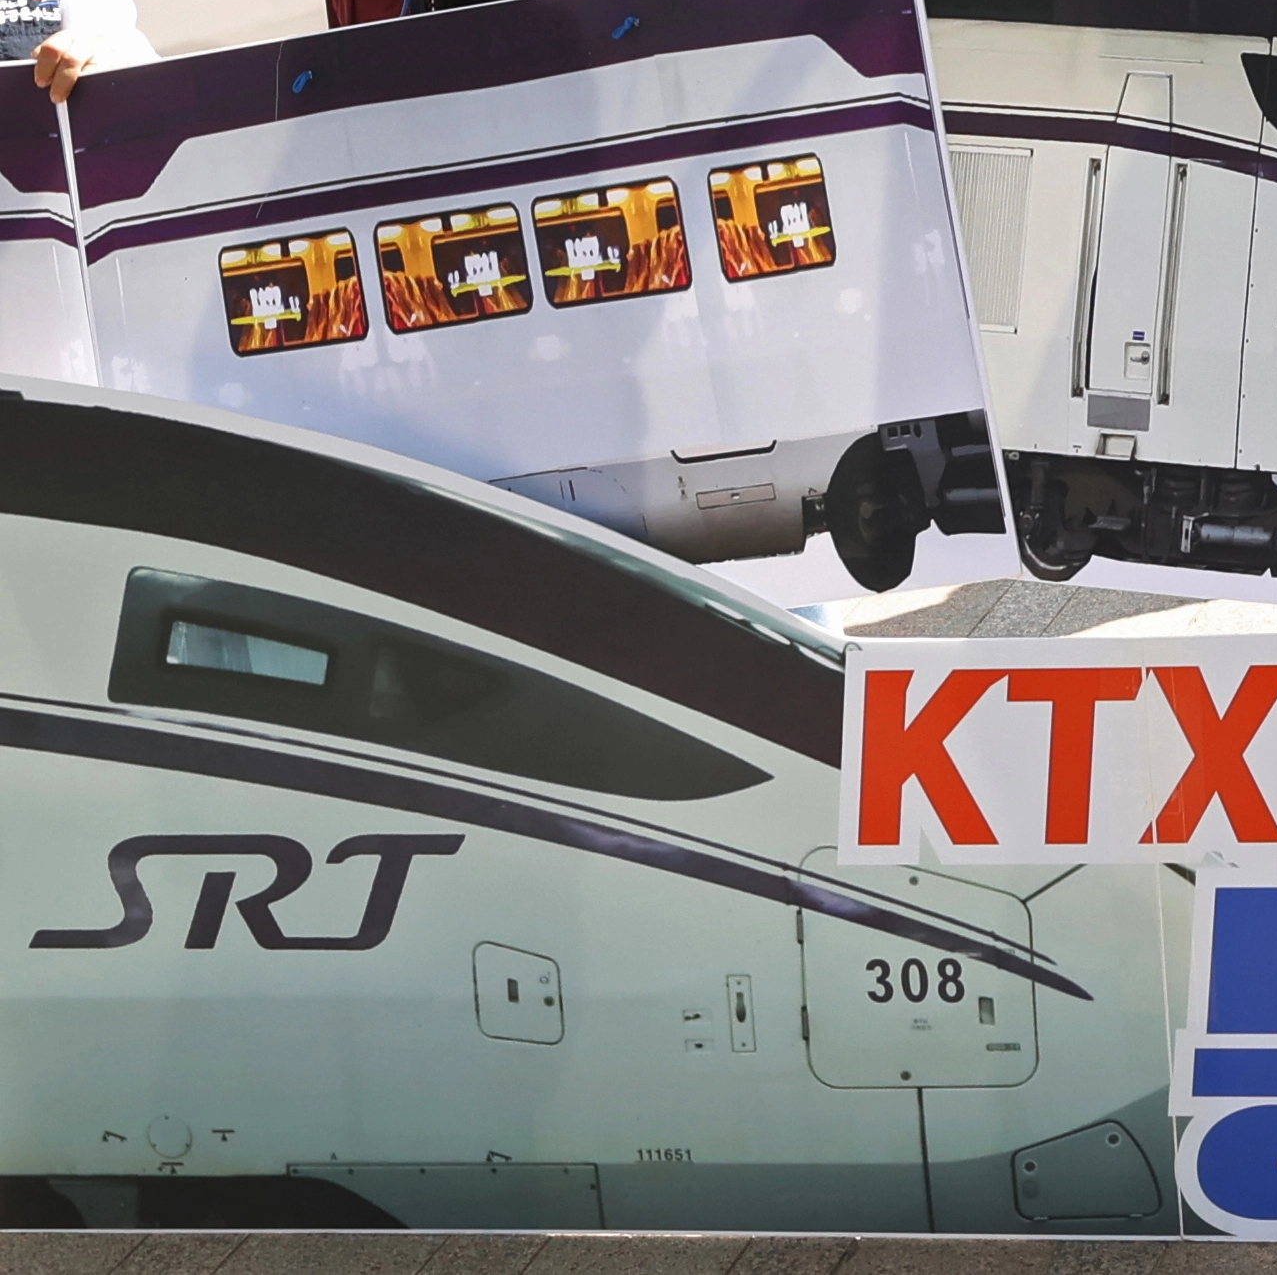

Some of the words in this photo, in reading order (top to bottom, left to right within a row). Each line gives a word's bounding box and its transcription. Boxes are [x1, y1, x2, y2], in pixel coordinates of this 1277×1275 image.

[28, 832, 466, 951] SRT
[865, 957, 965, 1004] 308
[636, 1147, 693, 1162] 111651
